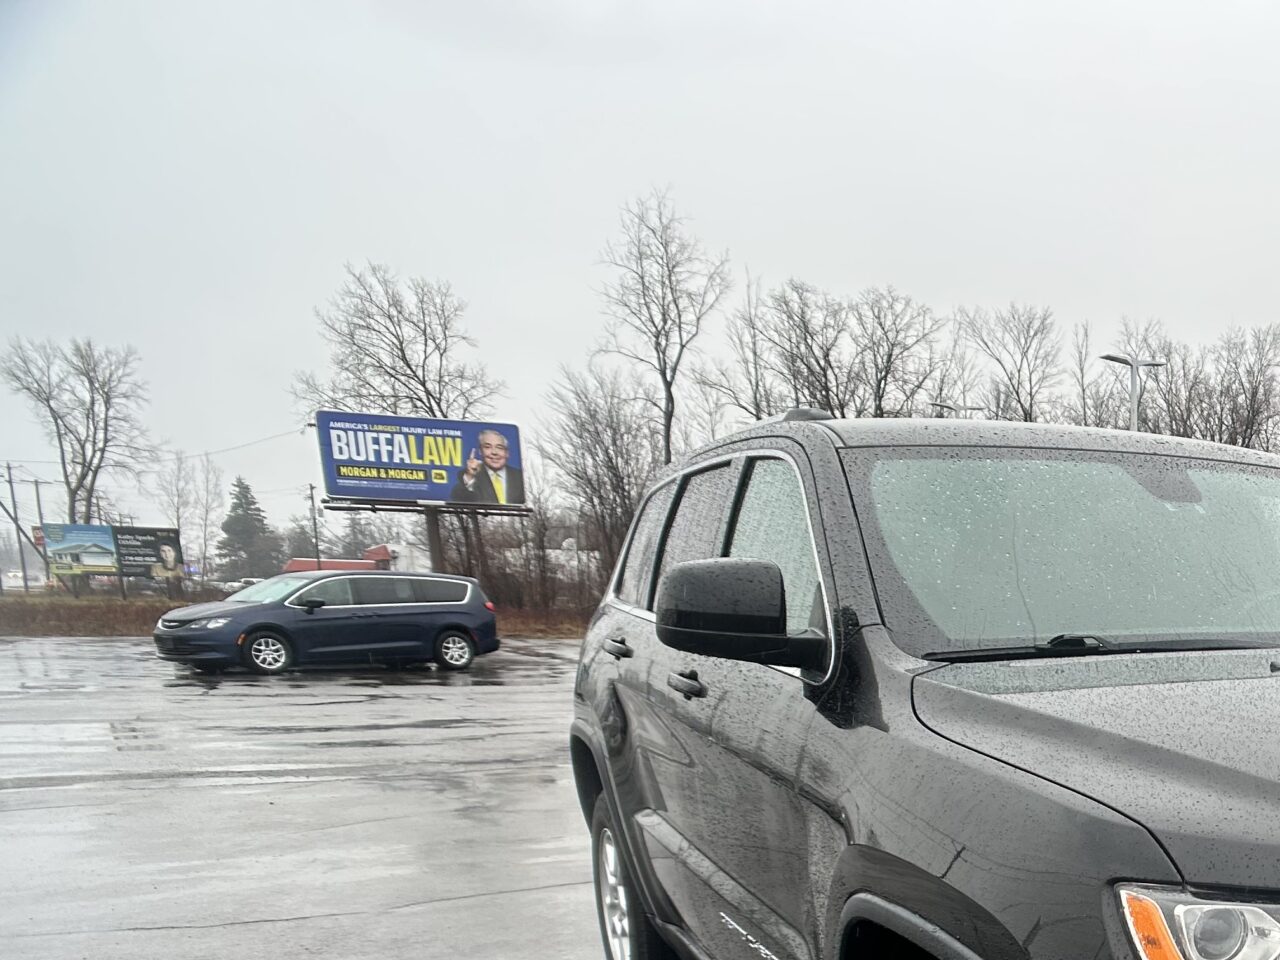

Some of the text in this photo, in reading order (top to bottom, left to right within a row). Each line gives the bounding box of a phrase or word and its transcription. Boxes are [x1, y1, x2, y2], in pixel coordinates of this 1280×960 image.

[329, 421, 462, 437] AMERICA'S LARGEST INJURY LAW FIRM
[329, 429, 463, 467] BUFFALAW
[339, 466, 378, 478] MORGAN
[379, 469, 386, 478] &
[388, 469, 425, 480] MORGAN
